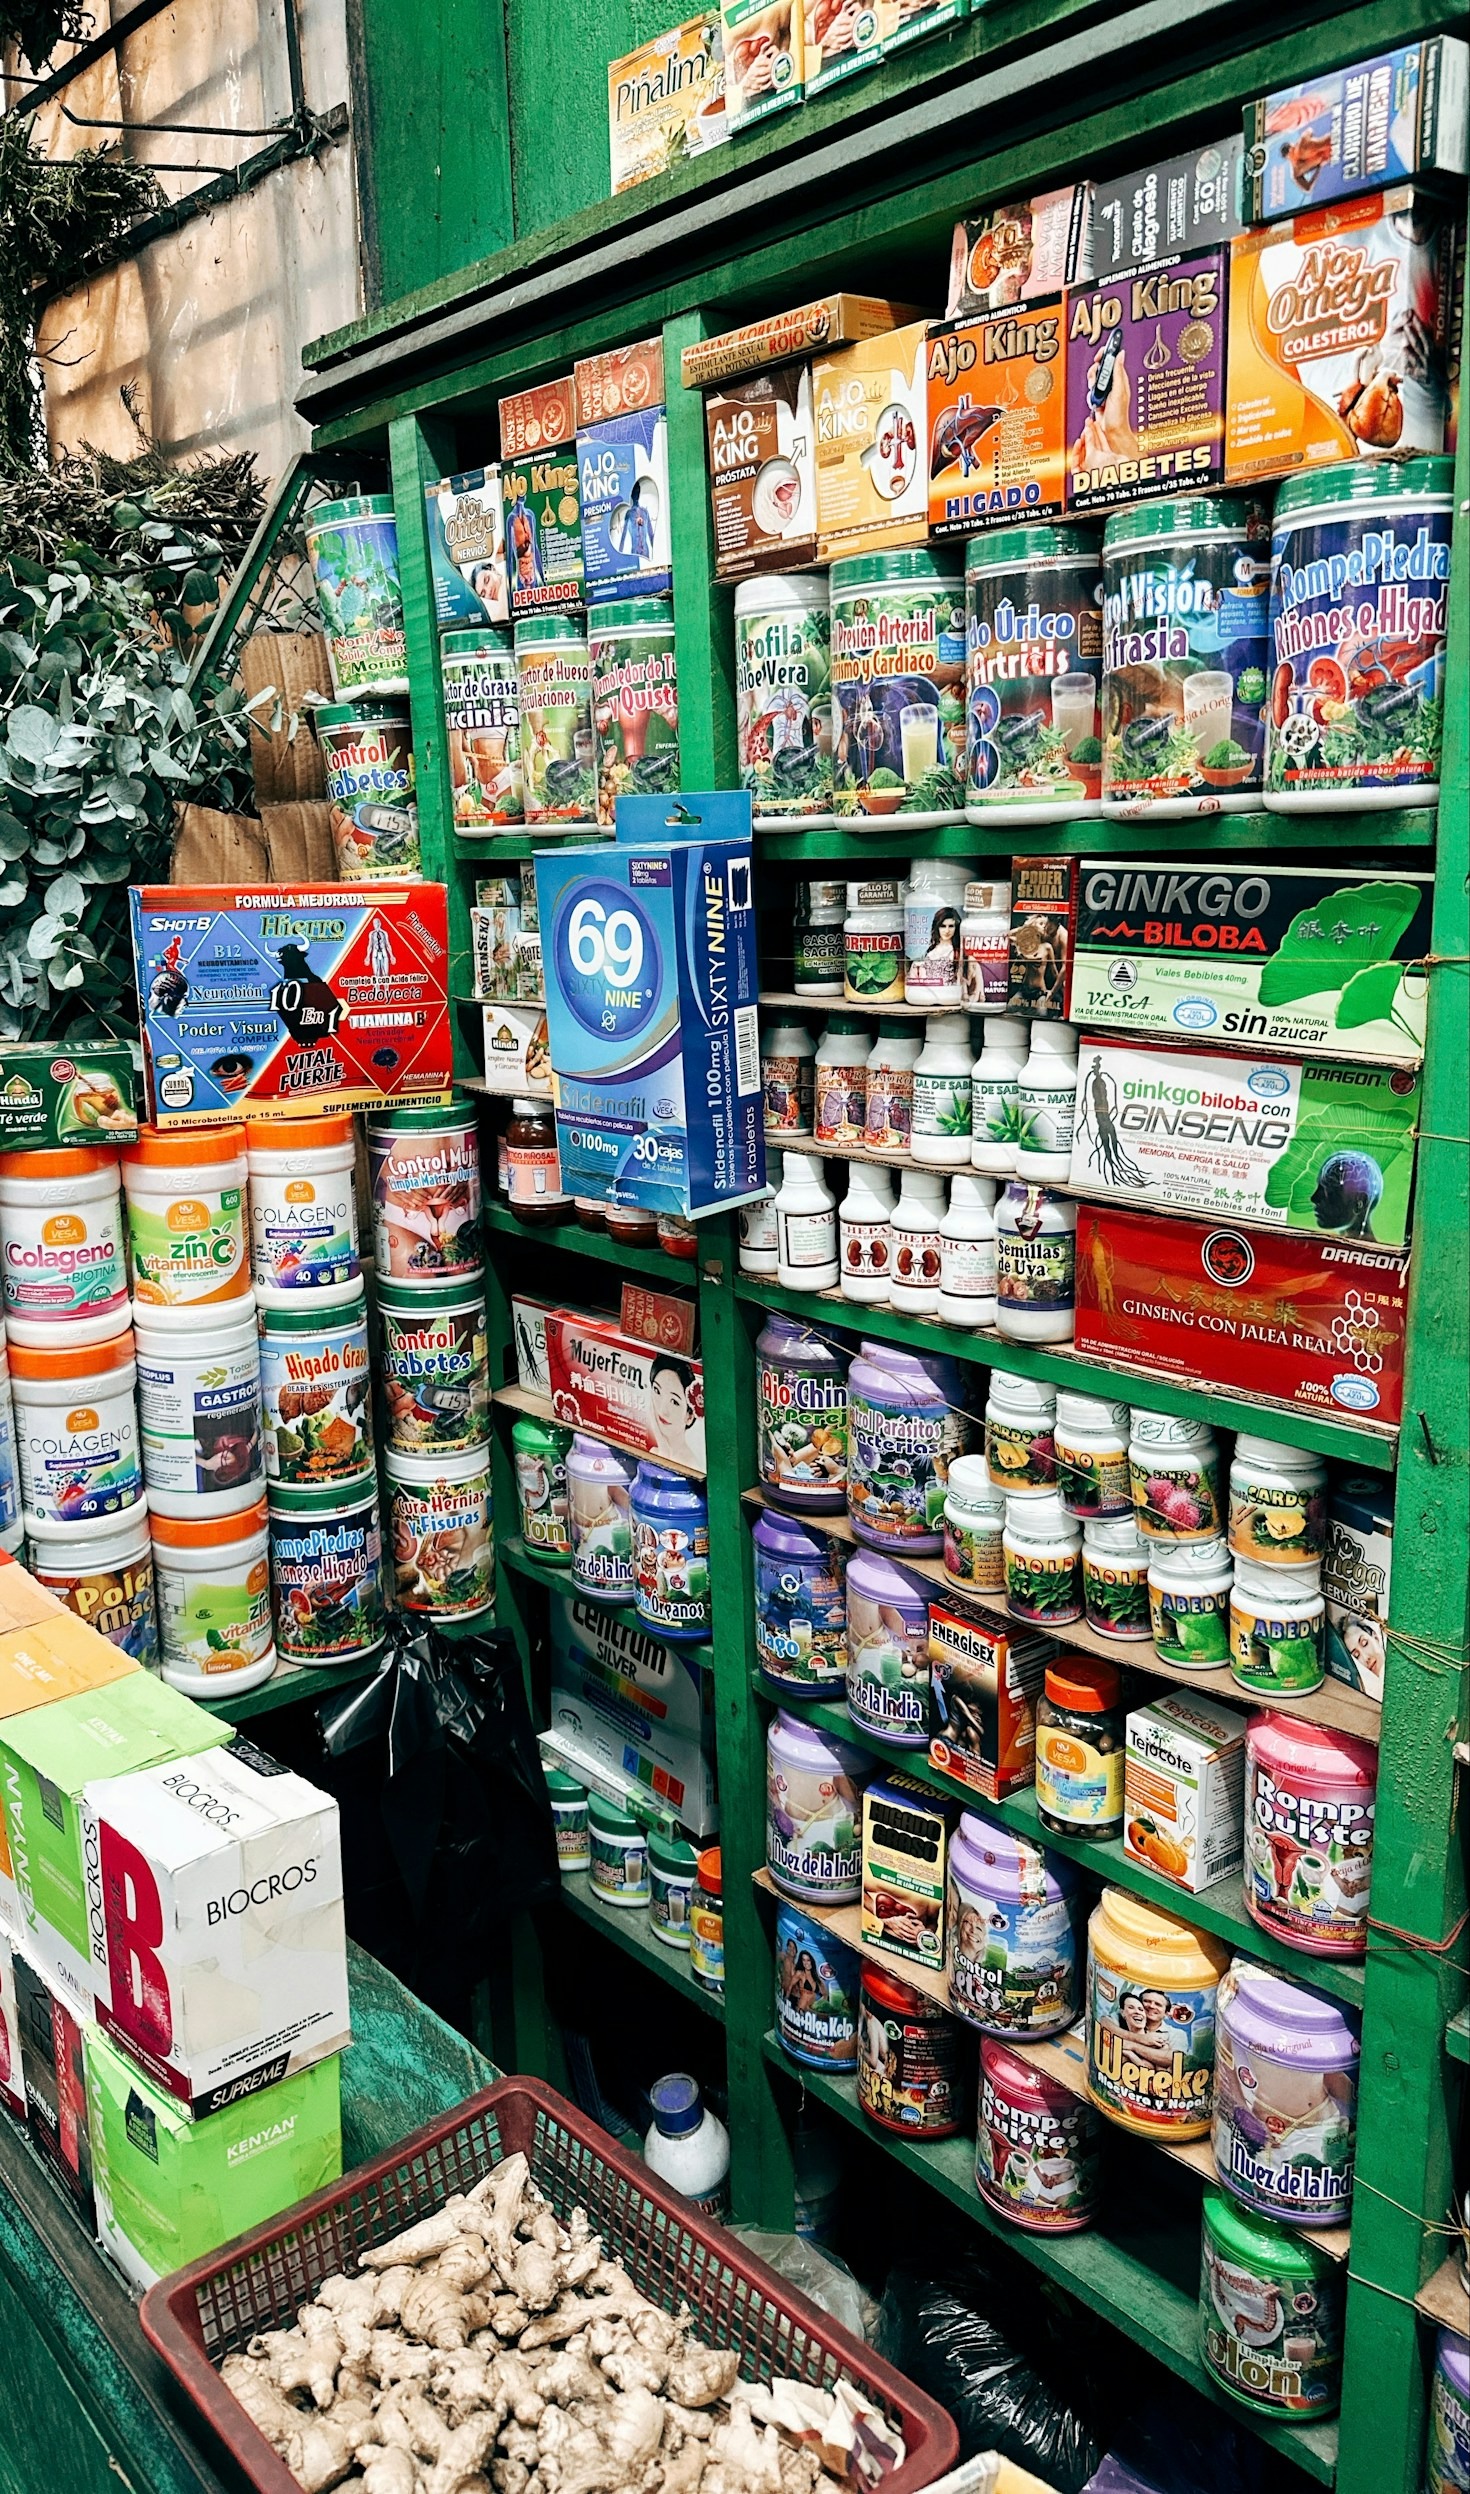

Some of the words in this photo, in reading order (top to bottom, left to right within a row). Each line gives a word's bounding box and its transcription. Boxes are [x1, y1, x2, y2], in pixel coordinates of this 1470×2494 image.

[615, 49, 709, 122] Piñalim
[1134, 189, 1143, 208] de
[1200, 182, 1214, 214] 60
[1142, 173, 1160, 262] Magnesio
[1132, 210, 1143, 257] Citrato
[1070, 294, 1123, 346] Ajo
[1131, 270, 1218, 322] King
[1266, 259, 1398, 334] Omega
[768, 329, 805, 355] ROJO
[927, 335, 977, 386] Ajo
[983, 316, 1060, 364] King
[1283, 322, 1378, 357] COLESTEROL
[689, 350, 736, 374] ESTIMULANTE
[734, 342, 766, 361] SEXUAL
[818, 379, 866, 415] AJO
[1148, 390, 1168, 401] Llagas
[1169, 388, 1177, 396] en
[1178, 385, 1184, 394] el
[1185, 382, 1207, 393] cuerpo
[817, 405, 868, 443] KING
[1148, 409, 1179, 421] Cansancio
[1180, 402, 1208, 414] Excesivo
[712, 409, 754, 444] AJO
[582, 451, 615, 474] AJO
[712, 433, 759, 471] KING
[715, 466, 756, 486] PRÓSTATA
[1073, 445, 1211, 493] DIABETES
[503, 473, 527, 505] Ajo
[531, 463, 580, 495] King
[582, 473, 620, 502] KING
[584, 502, 612, 518] PRESIÓN
[946, 482, 1040, 519] HIGADO
[445, 508, 496, 544] Omega
[457, 545, 487, 560] NERVIOS
[513, 581, 579, 607] DEPURADOR
[1130, 559, 1213, 617] Visión
[839, 616, 876, 649] Presión
[879, 610, 935, 645] Arterial
[995, 597, 1075, 642] Úrico
[862, 654, 870, 682] y
[873, 648, 935, 675] Cardiaco
[1299, 768, 1335, 779] Delicioso
[1337, 766, 1366, 778] batido
[1368, 765, 1394, 776] sabor
[1395, 764, 1425, 774] natural
[1017, 883, 1064, 899] SEXUAL
[1020, 870, 1062, 887] PODER
[236, 895, 296, 908] FORMULA
[299, 894, 365, 907] MEJORADA
[858, 889, 895, 900] GARANTÍA
[1084, 871, 1271, 919] GINKGO
[259, 914, 347, 938] Hierro
[705, 876, 723, 953] NINE
[910, 914, 929, 926] Mujer
[567, 898, 644, 988] 69
[845, 934, 902, 952] ORTIGA
[1144, 921, 1267, 952] BILOBA
[214, 945, 241, 958] B12
[340, 976, 371, 987] Complejo
[378, 975, 389, 984] con
[391, 974, 408, 983] Acido
[408, 973, 428, 983] Fólico
[1155, 967, 1181, 978] Viales
[1184, 969, 1223, 982] Bebibles
[1224, 973, 1249, 984] 40mg.
[191, 983, 264, 1001] Neurobión
[270, 980, 301, 1011] 10
[348, 986, 422, 1005] Bedoyecta
[605, 989, 642, 1010] NINE
[708, 955, 729, 1026] SIXTY
[1087, 992, 1154, 1009] VESA
[178, 1021, 227, 1037] Poder
[230, 1019, 278, 1035] Visual
[1094, 1010, 1150, 1021] ADMINISTRACION
[1150, 1013, 1168, 1022] ORAL
[1222, 1007, 1267, 1035] sin
[1272, 1015, 1291, 1024] 100%
[1293, 1018, 1329, 1028] NATURAL
[232, 1034, 279, 1044] COMPLEX
[493, 1039, 518, 1049] Hindú
[1268, 1024, 1328, 1044] azucar
[286, 1047, 335, 1072] VITAL
[402, 1072, 445, 1081] HEMAMINA
[1304, 1066, 1381, 1088] DRAGON
[322, 1100, 382, 1113] SUPLEMENTO
[383, 1095, 442, 1107] ALIMENTICIO
[560, 1081, 647, 1120] Sildenafil
[747, 1105, 758, 1170] tabletas
[1119, 1102, 1291, 1149] GINSENG
[580, 1131, 619, 1157] 100mg
[632, 1133, 658, 1162] 30
[658, 1146, 684, 1161] cajas
[713, 1108, 727, 1189] Sildenafil
[1138, 1146, 1177, 1160] MEMORIA,
[1178, 1152, 1214, 1165] ENERGIA
[1222, 1159, 1251, 1170] SALUD
[748, 1174, 758, 1184] 2
[174, 1214, 201, 1225] VESA
[253, 1202, 348, 1223] COLÁGENO
[50, 1228, 78, 1239] VESA
[6, 1240, 114, 1273] Colageno
[143, 1247, 214, 1271] vitamina
[998, 1239, 1060, 1260] Semillas
[1321, 1246, 1406, 1272] DRAGON
[63, 1264, 116, 1283] +BIOTINA
[172, 1269, 219, 1279] efervescente
[296, 1270, 311, 1282] 40
[634, 1291, 644, 1336] KOREAN
[1122, 1299, 1196, 1331] GINSENG
[1197, 1314, 1237, 1334] CON
[1240, 1321, 1289, 1346] JALEA
[1292, 1332, 1337, 1356] REAL
[389, 1322, 456, 1350] Control
[1294, 1389, 1335, 1406] NATURAL
[1299, 1381, 1329, 1395] 100%
[30, 1423, 132, 1454] COLÁGENO
[875, 1413, 941, 1438] Parásitos
[1153, 1469, 1190, 1481] SANTO
[80, 1499, 98, 1513] 40
[431, 1489, 484, 1511] Hernias
[323, 1552, 368, 1582] Higado
[651, 1586, 704, 1620] Órganos
[207, 1661, 232, 1673] limón
[596, 1641, 638, 1682] SILVER
[232, 1743, 285, 1778] SUPREME
[1052, 1750, 1077, 1767] VESA
[1129, 1728, 1193, 1775] Tejocote
[161, 1773, 241, 1827] BIOCROS
[869, 1801, 942, 1841] HIGADO
[872, 1825, 938, 1865] GRASO
[80, 1817, 107, 1966] BIOCROS
[205, 1856, 319, 1927] BIOCROS
[866, 1934, 902, 1955] SUPLEMENTO
[903, 1949, 938, 1968] ALIMENTICIO
[954, 1946, 1002, 1985] Control
[1093, 2018, 1210, 2099] Wereke
[210, 2058, 286, 2110] SUPREME
[983, 2078, 1079, 2130] Rompe
[982, 2096, 1079, 2149] Quistes
[226, 2117, 296, 2162] KENYAN
[1239, 2343, 1302, 2371] Limpiador
